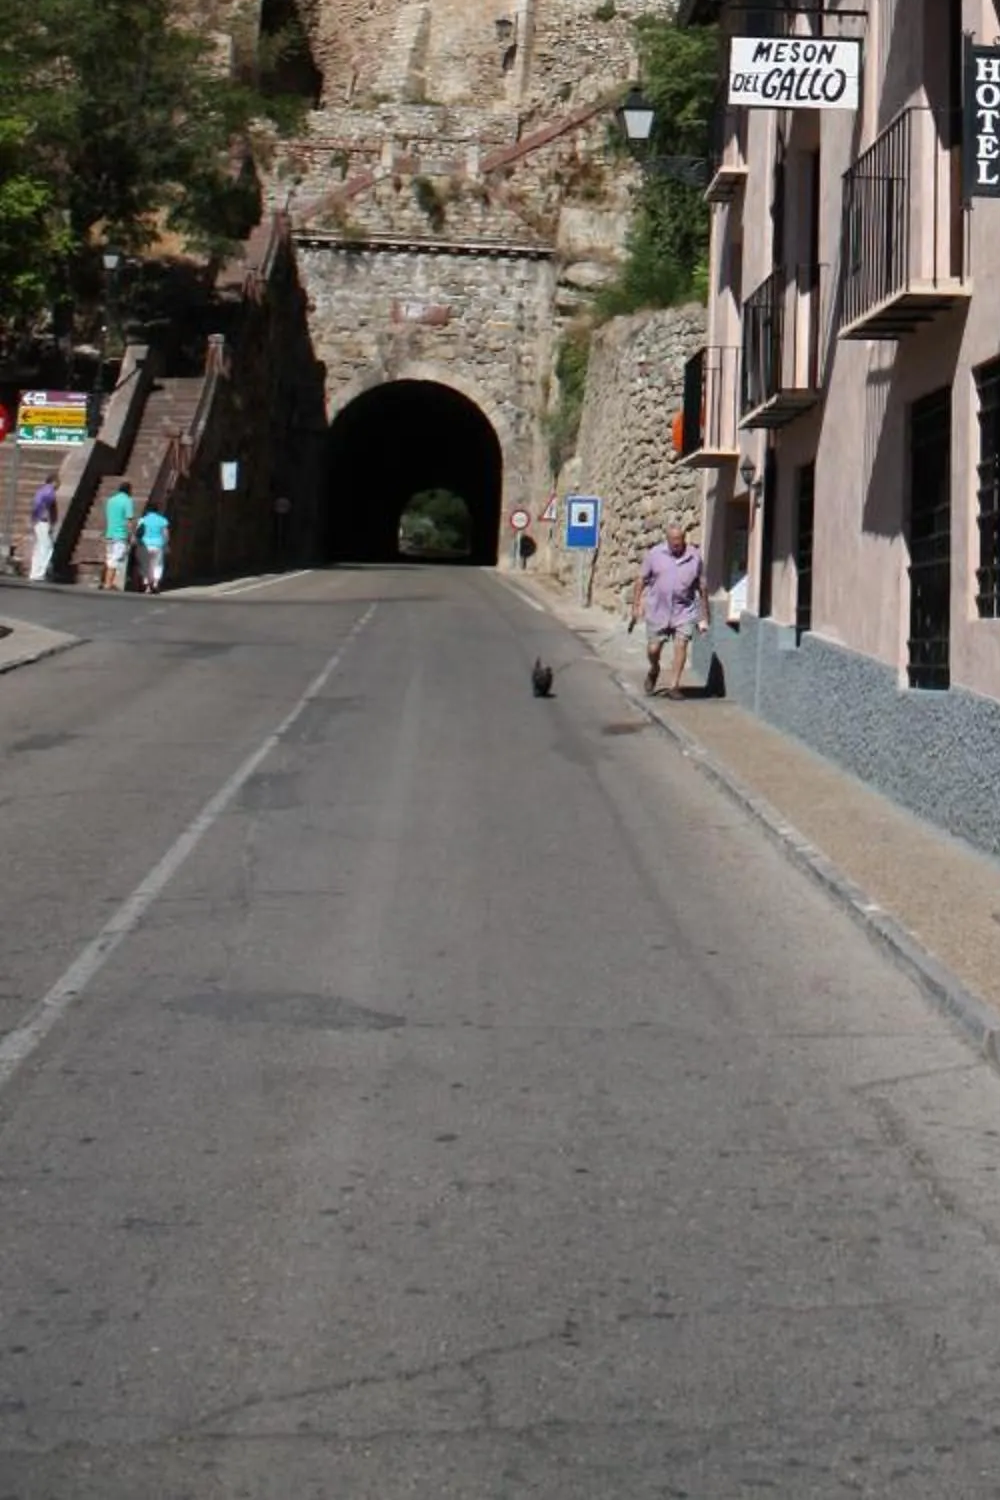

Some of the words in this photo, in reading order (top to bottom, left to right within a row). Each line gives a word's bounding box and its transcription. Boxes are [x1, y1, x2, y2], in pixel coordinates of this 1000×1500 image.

[751, 41, 837, 64] MESON
[731, 72, 760, 93] DEL
[761, 67, 847, 103] GALLO
